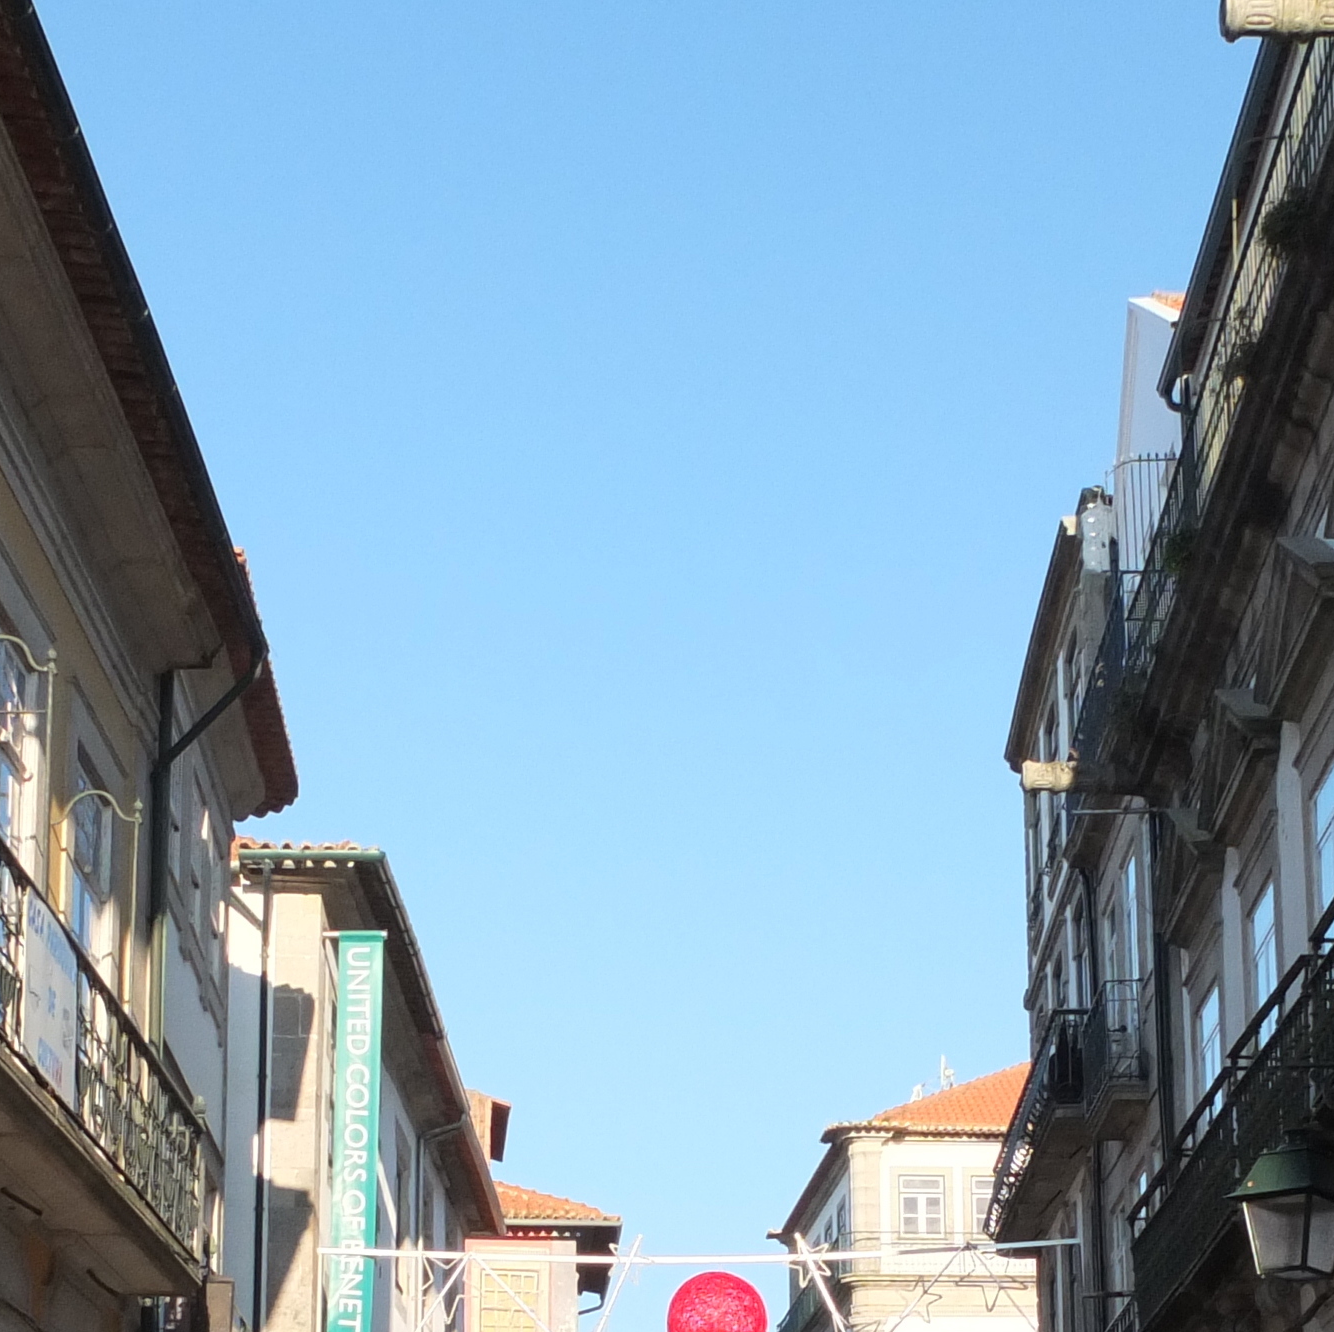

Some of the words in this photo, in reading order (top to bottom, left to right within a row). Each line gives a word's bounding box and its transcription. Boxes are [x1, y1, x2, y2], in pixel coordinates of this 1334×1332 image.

[346, 946, 371, 1055] UNITED
[342, 1062, 370, 1183] COLORS
[340, 1189, 366, 1236] OF
